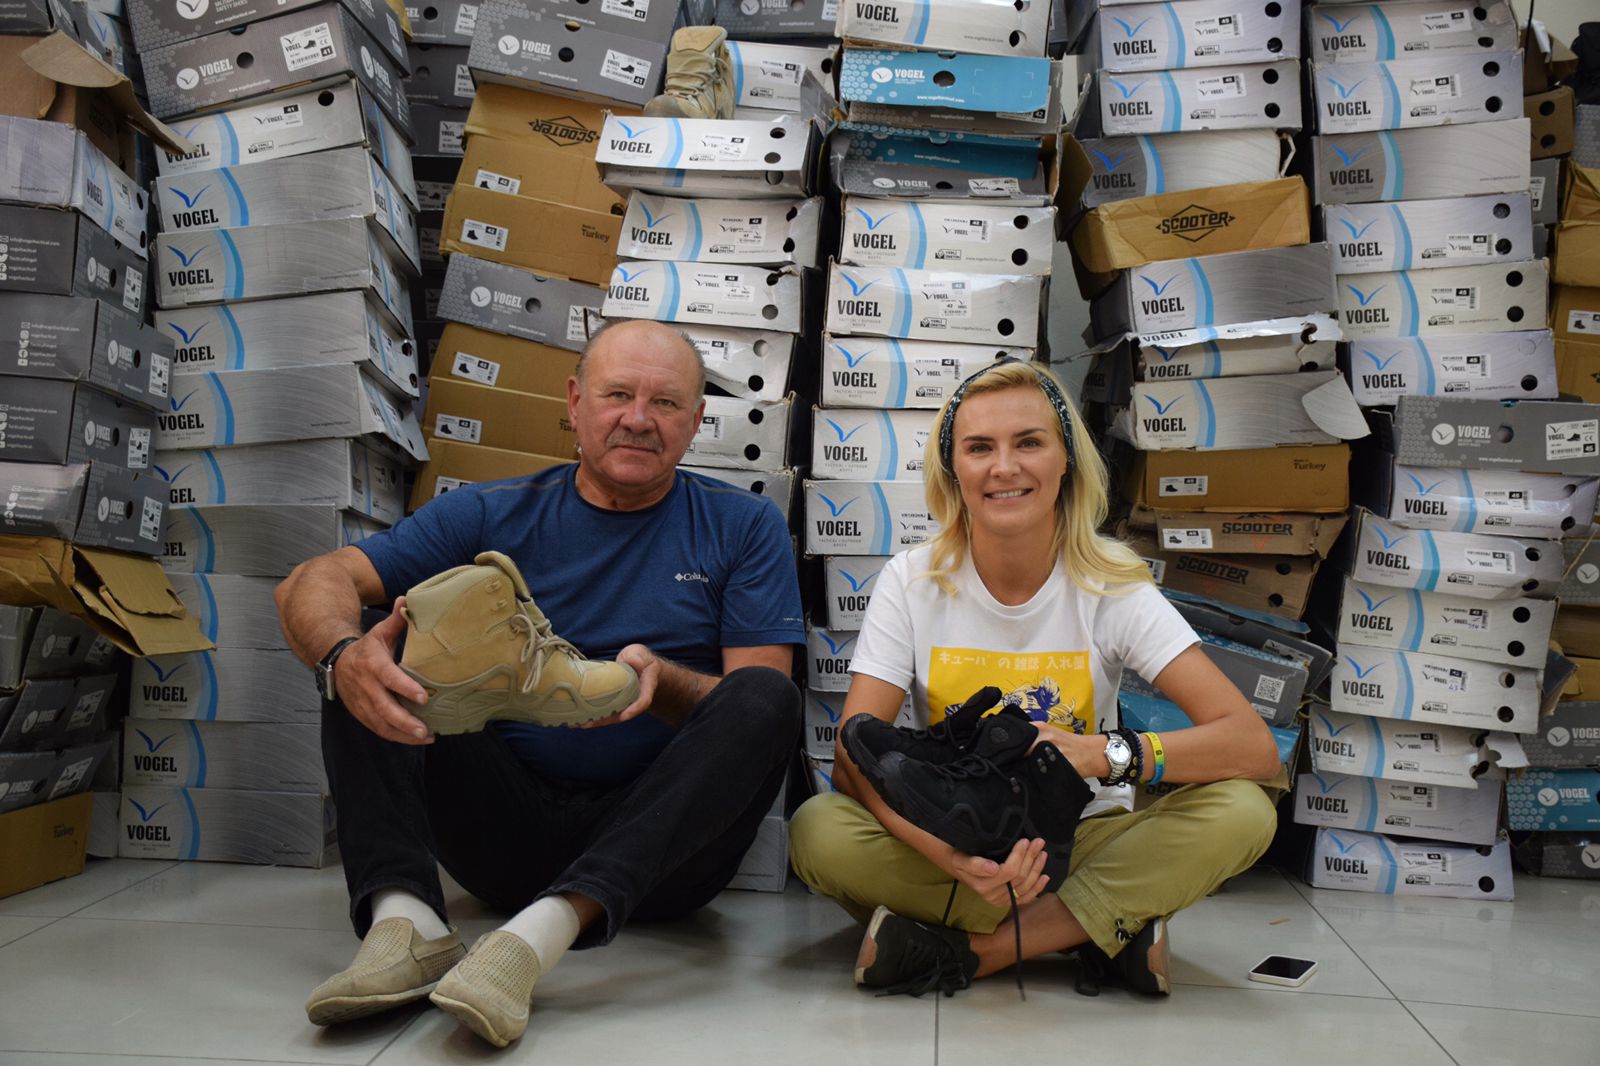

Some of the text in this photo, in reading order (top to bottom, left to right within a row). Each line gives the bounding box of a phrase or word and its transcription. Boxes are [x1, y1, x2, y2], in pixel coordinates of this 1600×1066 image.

[405, 7, 419, 18] GEL
[856, 2, 900, 23] VOGEL
[522, 39, 552, 55] VOGEL
[1113, 39, 1157, 56] VOGEL
[1321, 35, 1366, 51] VOGEL
[200, 59, 233, 77] VOGEL
[895, 68, 925, 79] VOGEL
[1109, 101, 1153, 117] VOGEL
[1328, 101, 1371, 117] VOGEL
[532, 119, 598, 143] SCOOTER
[610, 139, 653, 154] VOGEL
[897, 179, 931, 188] VOGEL
[1092, 173, 1136, 190] VOGEL
[1329, 169, 1374, 186] VOGEL
[87, 178, 104, 207] VOGEL
[172, 208, 219, 229] VOGEL
[1162, 210, 1228, 234] SCOOTER
[582, 229, 610, 243] Turkey
[631, 227, 673, 246] VOGEL
[853, 233, 896, 249] VOGEL
[1339, 242, 1383, 258] VOGEL
[168, 269, 214, 287] VOGEL
[493, 291, 522, 309] VOGEL
[608, 286, 650, 302] VOGEL
[837, 299, 881, 317] VOGEL
[1142, 297, 1185, 315] VOGEL
[1346, 308, 1389, 324] VOGEL
[1149, 363, 1192, 377] VOGEL
[832, 371, 877, 387] VOGEL
[1362, 373, 1406, 389] VOGEL
[158, 413, 204, 431] VOGEL
[1143, 417, 1186, 433] VOGEL
[1458, 425, 1492, 439] VOGEL
[823, 445, 868, 462] VOGEL
[1294, 462, 1326, 472] Turkey
[170, 487, 195, 504] GEL
[1404, 499, 1448, 515] VOGEL
[816, 520, 861, 536] VOGEL
[1222, 522, 1293, 535] SCOOTER
[163, 542, 187, 557] GEL
[1367, 550, 1410, 570] VOGEL
[1176, 555, 1249, 585] SCOOTER
[837, 595, 872, 612] VOG
[1351, 613, 1394, 632] VOGEL
[816, 659, 852, 674] VOGE
[998, 658, 1010, 668] の
[143, 685, 188, 702] VOGEL
[1342, 680, 1384, 699] VOGEL
[1315, 738, 1356, 758] VOGEL
[134, 755, 178, 772] VOGEL
[1559, 788, 1590, 799] VOGEL
[1307, 795, 1349, 814] VOGEL
[127, 825, 171, 841] VOGEL
[1324, 856, 1368, 874] VOGEL
